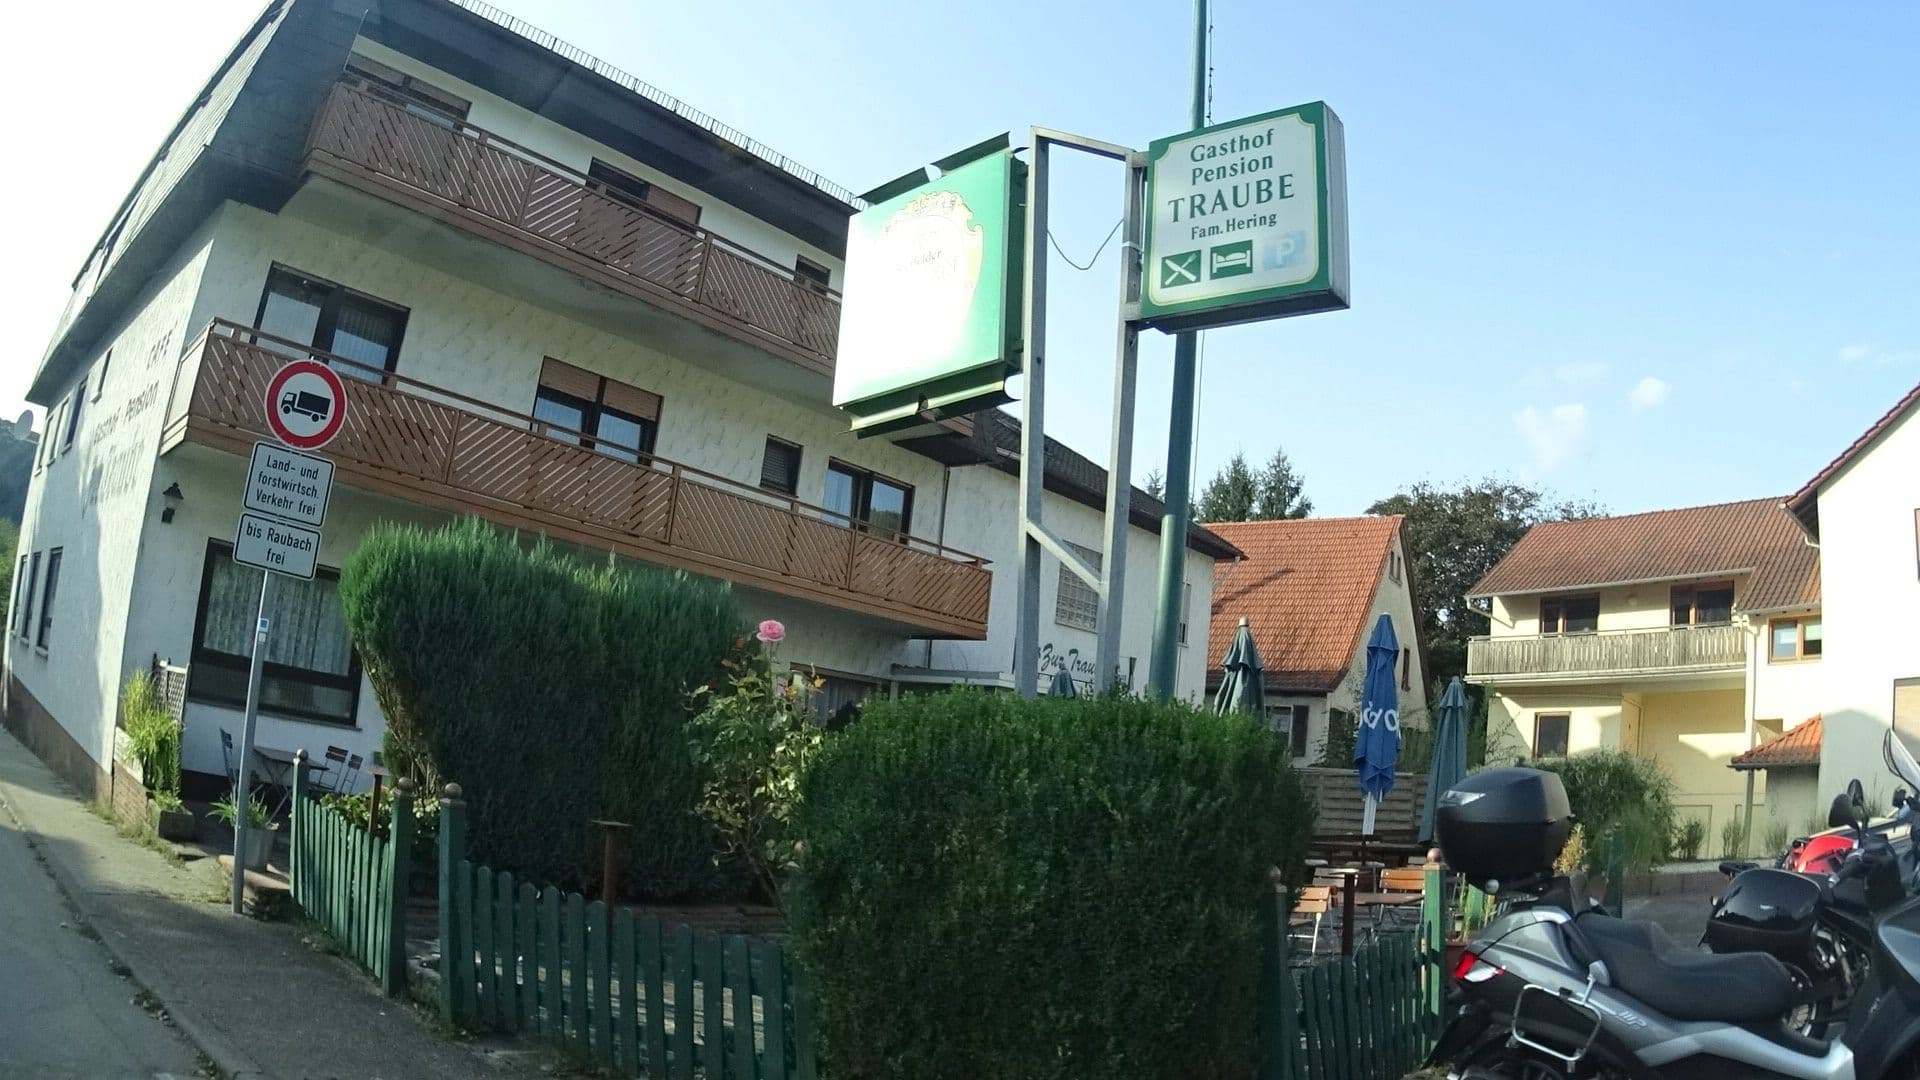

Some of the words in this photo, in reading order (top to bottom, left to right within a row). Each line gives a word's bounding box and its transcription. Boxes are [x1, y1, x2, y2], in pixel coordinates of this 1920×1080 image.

[1190, 128, 1275, 163] Gasthof
[1191, 155, 1274, 186] Pension
[1168, 174, 1295, 223] TRAUBE
[266, 454, 296, 473] Land-
[300, 466, 319, 480] und
[258, 470, 320, 500] forstwirtsch.
[256, 488, 295, 510] Verkehr
[298, 500, 316, 516] frei
[246, 521, 262, 539] bis
[267, 527, 312, 552] Raubach
[266, 548, 286, 565] frei
[1068, 648, 1096, 675] Trau
